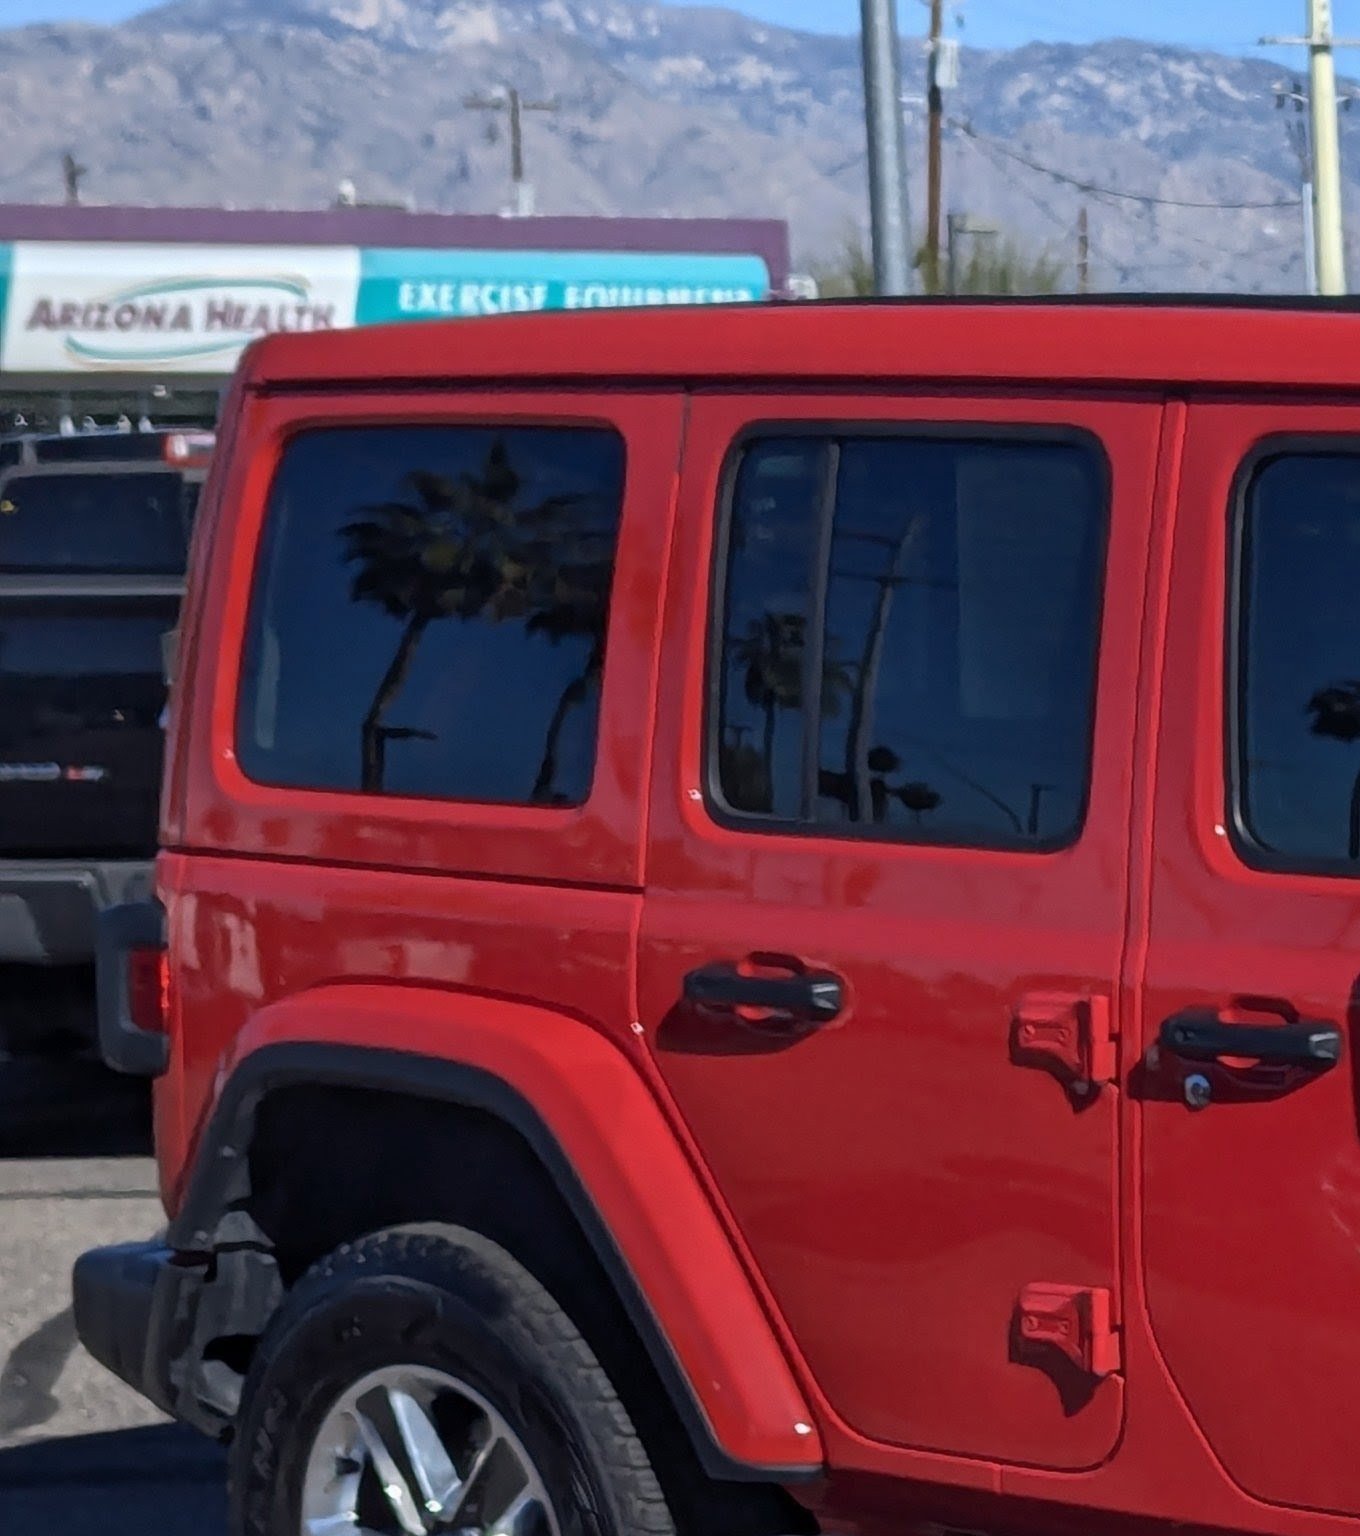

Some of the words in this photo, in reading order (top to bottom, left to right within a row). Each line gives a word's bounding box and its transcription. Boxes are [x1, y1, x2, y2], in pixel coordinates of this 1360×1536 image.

[399, 281, 548, 313] EXERCISE
[25, 299, 193, 331] ARIZONA
[204, 299, 337, 333] HEALTH
